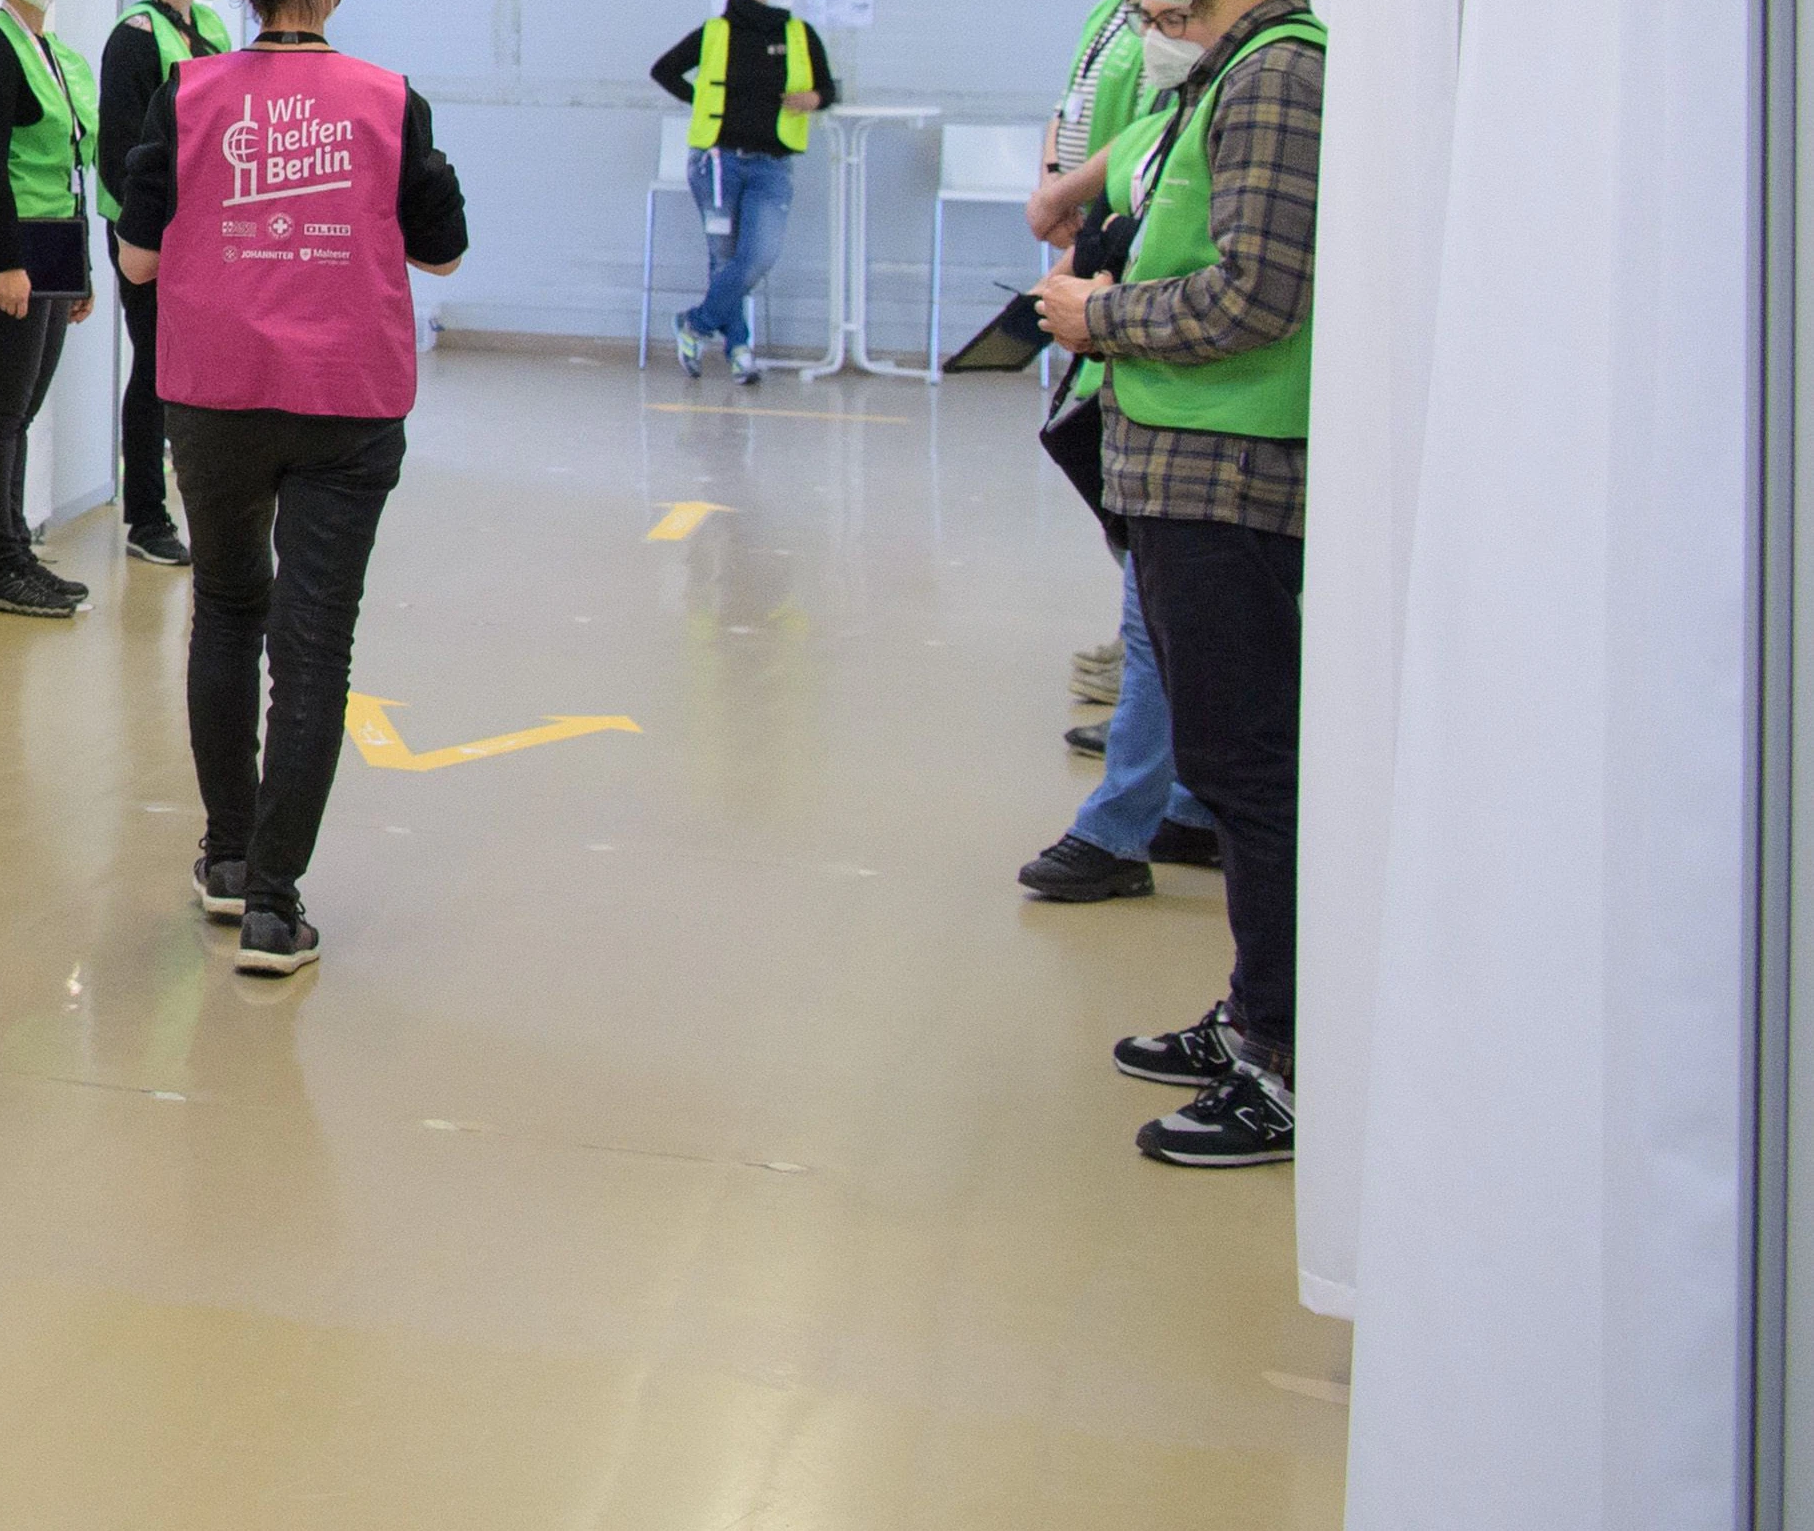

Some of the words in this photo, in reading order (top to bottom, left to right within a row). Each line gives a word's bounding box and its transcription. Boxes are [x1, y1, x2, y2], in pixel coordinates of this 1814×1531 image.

[266, 94, 315, 124] Wir
[267, 118, 353, 154] helfen
[266, 145, 352, 184] Berlin
